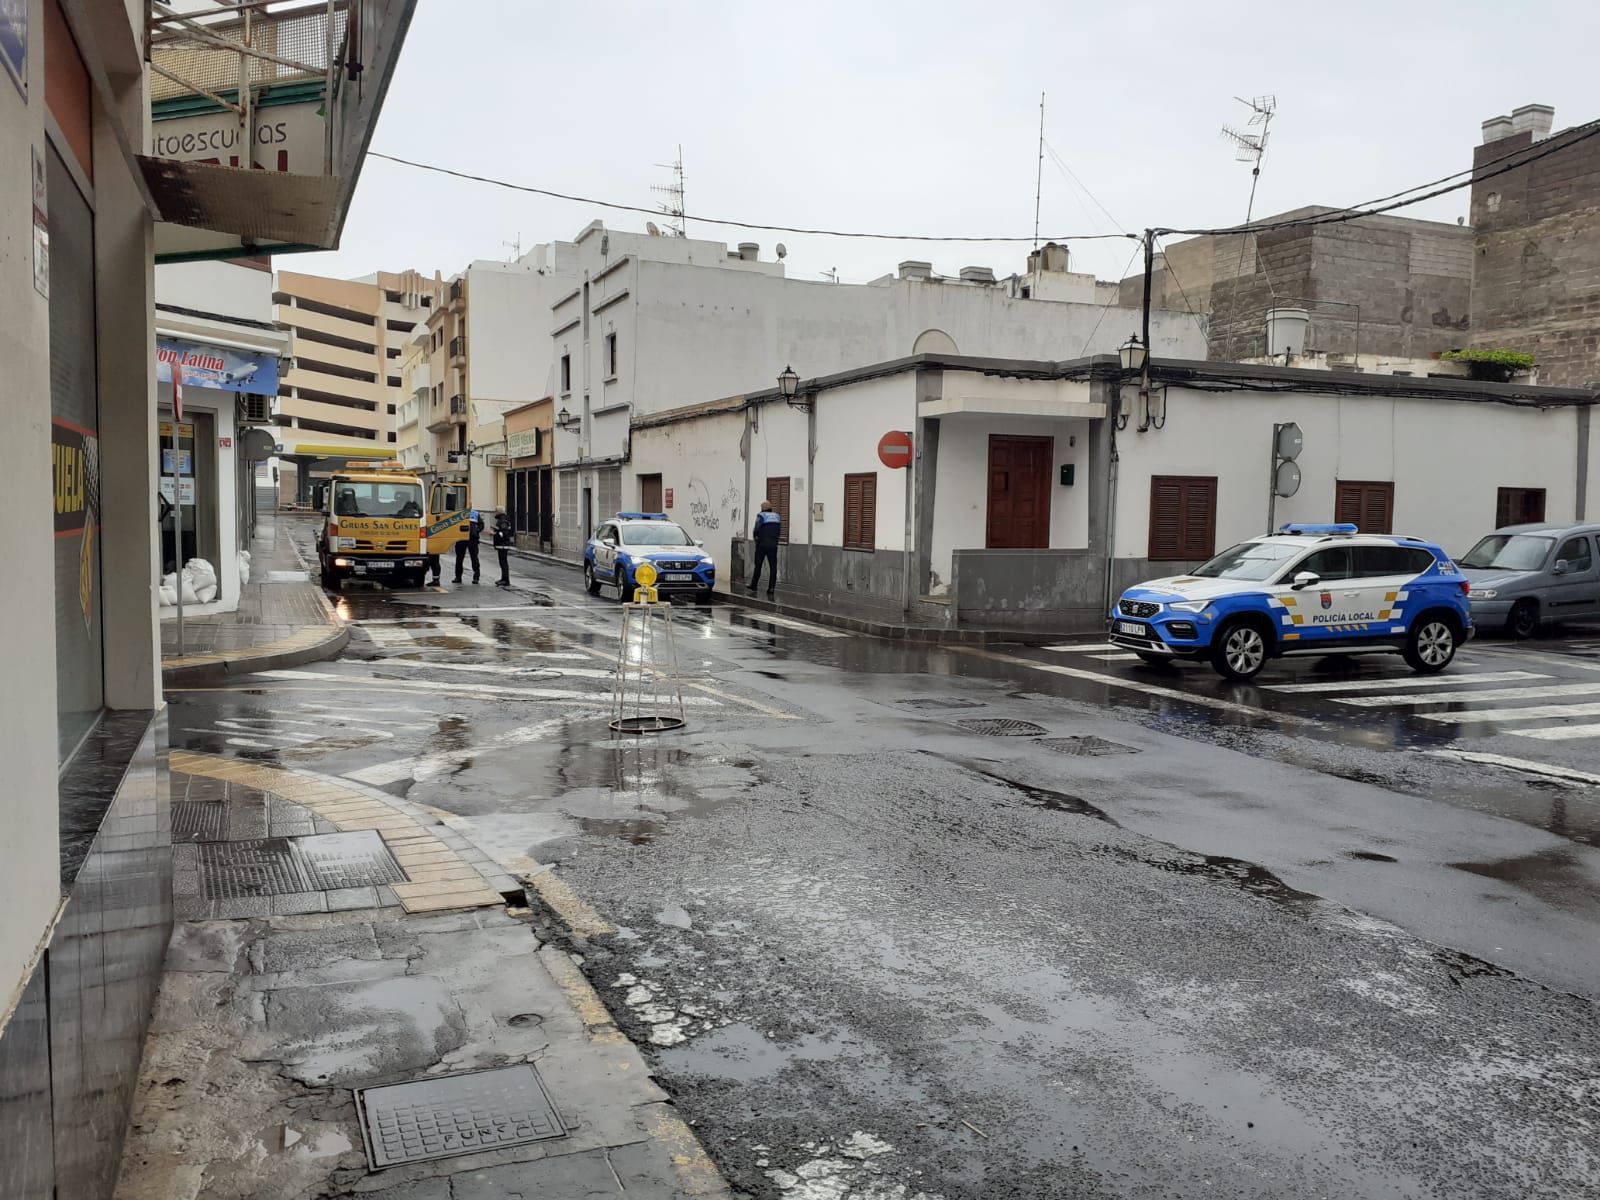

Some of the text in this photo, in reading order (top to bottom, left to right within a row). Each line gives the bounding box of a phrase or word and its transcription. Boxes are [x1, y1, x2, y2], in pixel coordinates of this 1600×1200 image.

[181, 351, 224, 371] Latina
[372, 520, 389, 530] SAN
[1348, 612, 1374, 621] LOCAL
